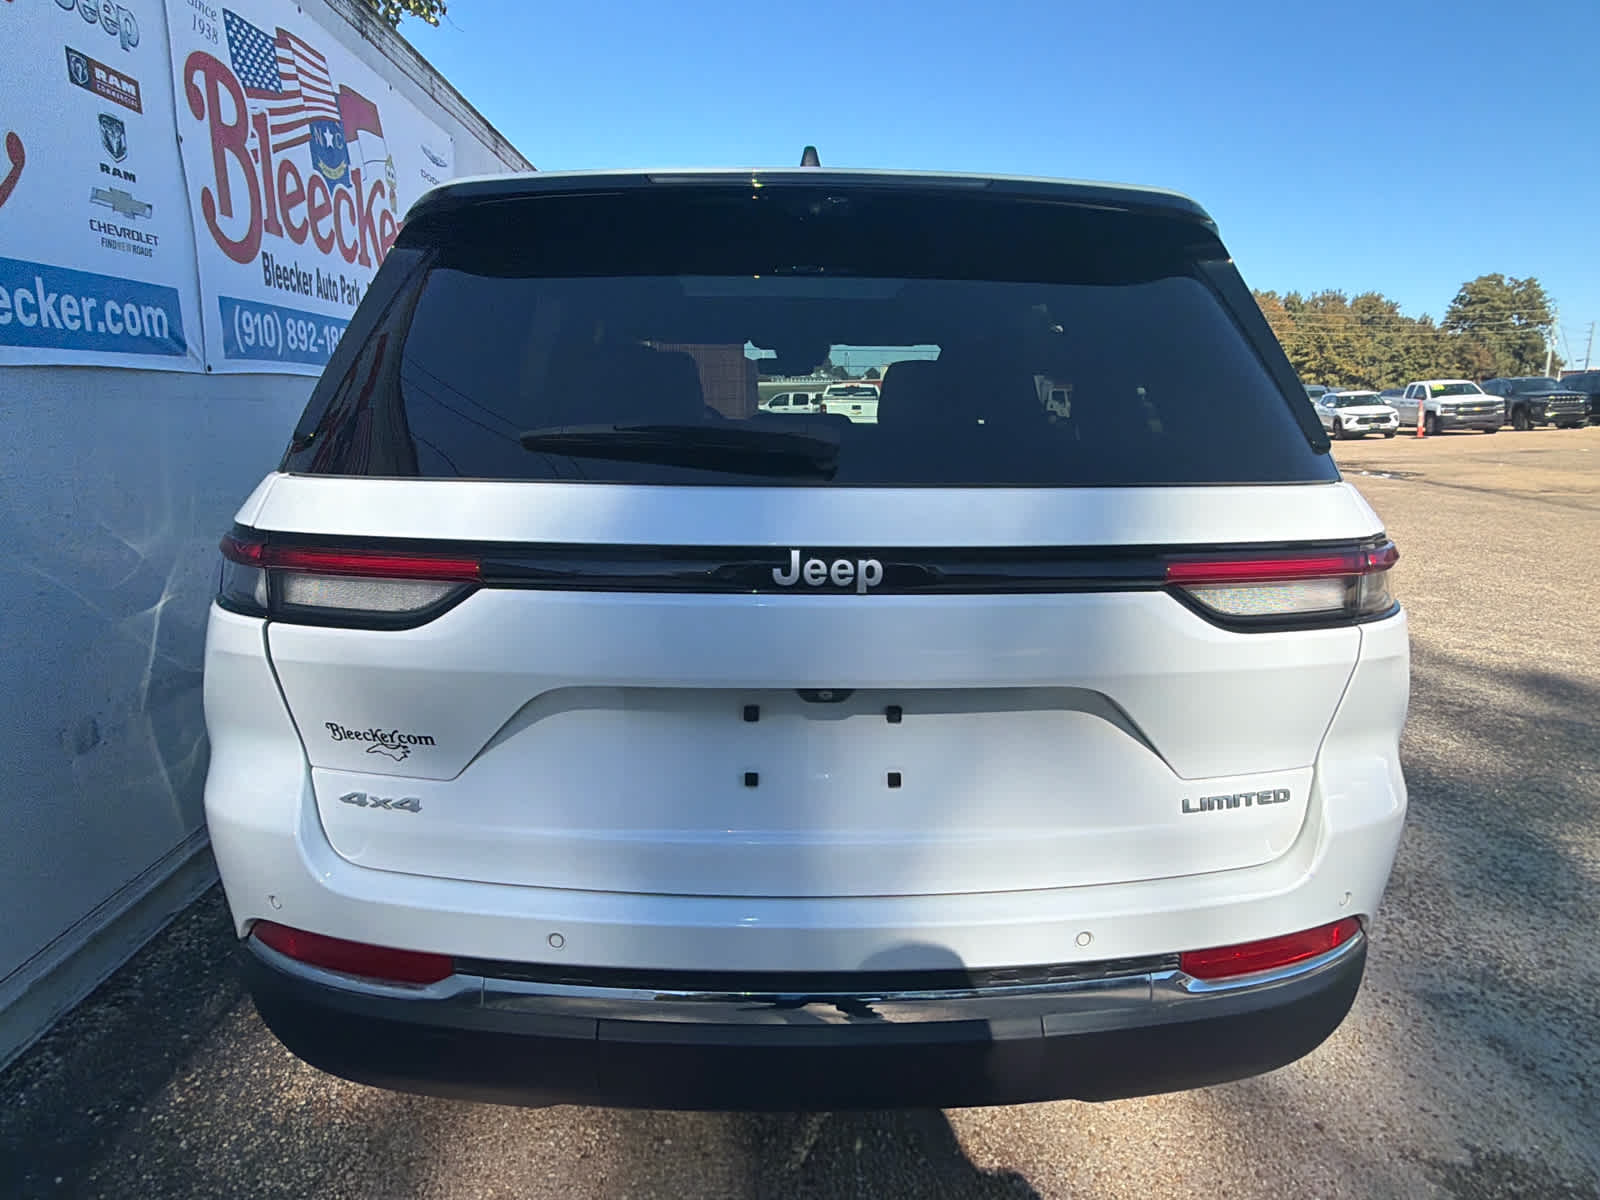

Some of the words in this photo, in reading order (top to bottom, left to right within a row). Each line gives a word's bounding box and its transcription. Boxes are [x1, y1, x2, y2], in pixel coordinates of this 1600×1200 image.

[55, 0, 140, 52] eep
[193, 14, 218, 45] 1938
[95, 67, 137, 97] RAM
[99, 163, 137, 183] RAM
[184, 51, 404, 267] Bleecke
[89, 218, 160, 247] CHEVROLET
[101, 237, 117, 250] FIND
[132, 243, 153, 258] ROADS
[262, 251, 313, 297] Bleecker
[316, 267, 339, 303] Auto
[339, 274, 361, 307] Park
[234, 304, 283, 356] (910)
[772, 549, 884, 594] Jeep
[339, 792, 423, 813] 4x4
[1182, 788, 1291, 814] LIMITED
